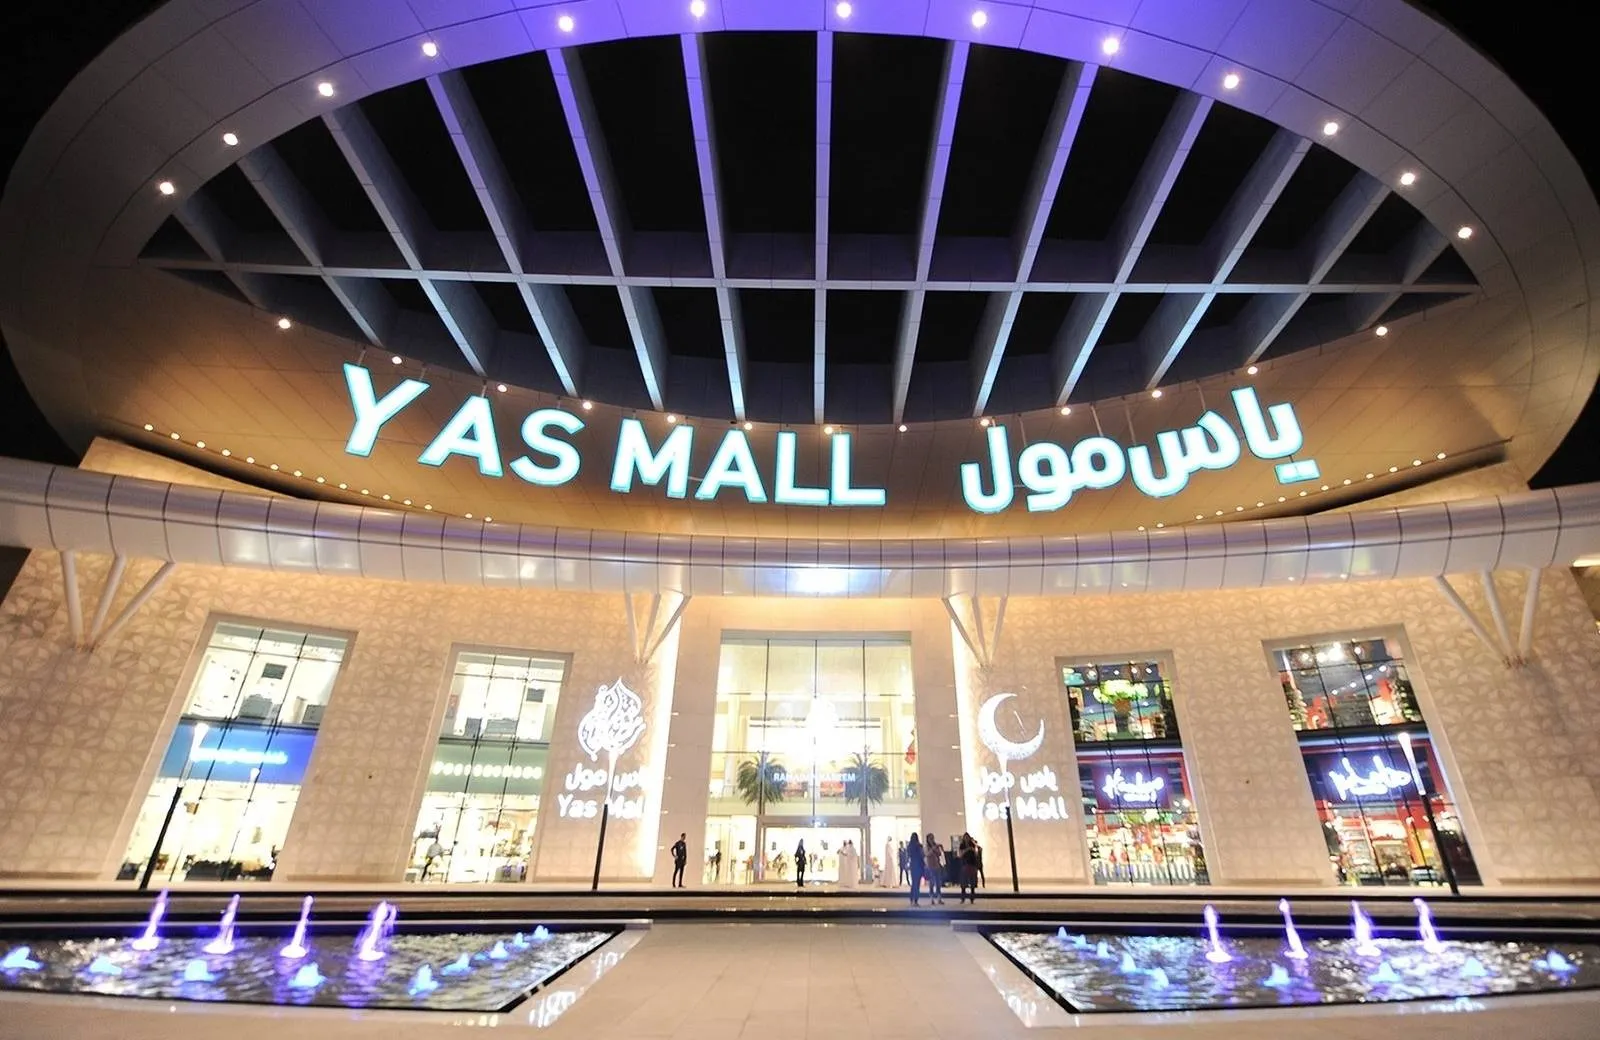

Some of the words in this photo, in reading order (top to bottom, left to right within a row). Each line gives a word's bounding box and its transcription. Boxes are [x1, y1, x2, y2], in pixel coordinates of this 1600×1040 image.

[342, 362, 586, 486] YAS
[609, 418, 887, 507] MALL
[959, 425, 1126, 514] مول
[1127, 386, 1321, 498] ياس
[558, 793, 599, 818] Yas
[605, 794, 650, 819] Mal
[1015, 796, 1069, 820] Mall
